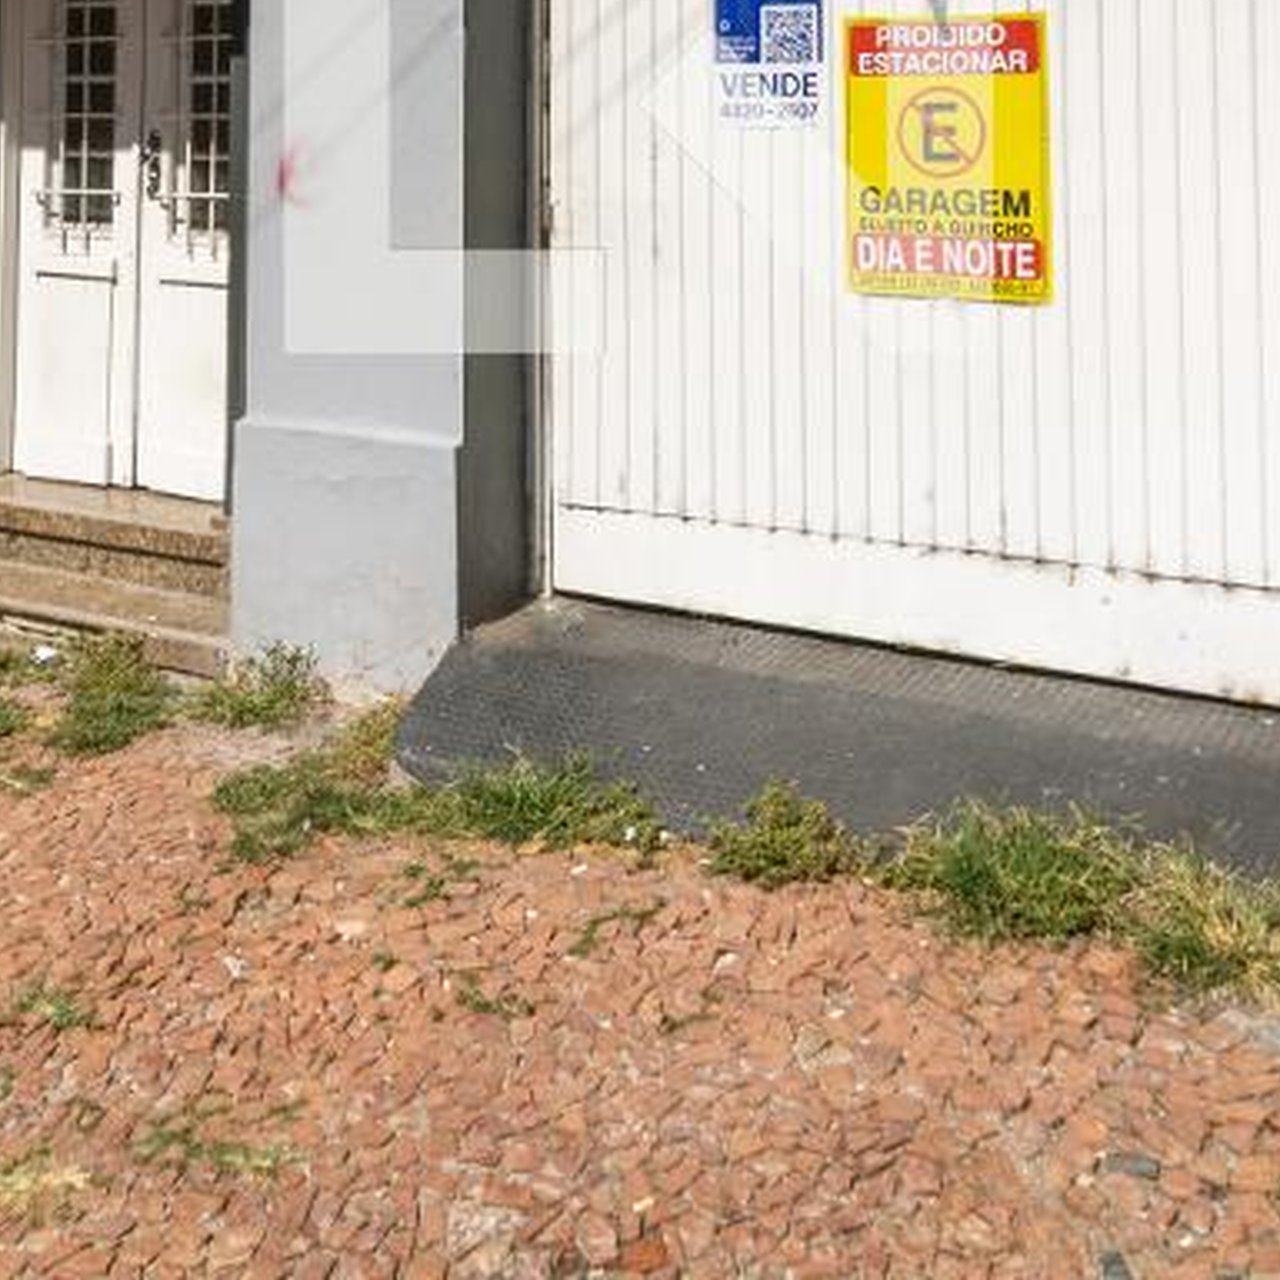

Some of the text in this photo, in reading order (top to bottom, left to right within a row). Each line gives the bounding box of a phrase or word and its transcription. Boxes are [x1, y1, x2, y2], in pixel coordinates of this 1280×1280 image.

[857, 50, 1028, 75] ESTACIONAR
[721, 72, 819, 97] VENDE
[922, 102, 959, 163] E
[859, 186, 1032, 218] GARAGEM
[856, 236, 1036, 279] DIA E NOITE
